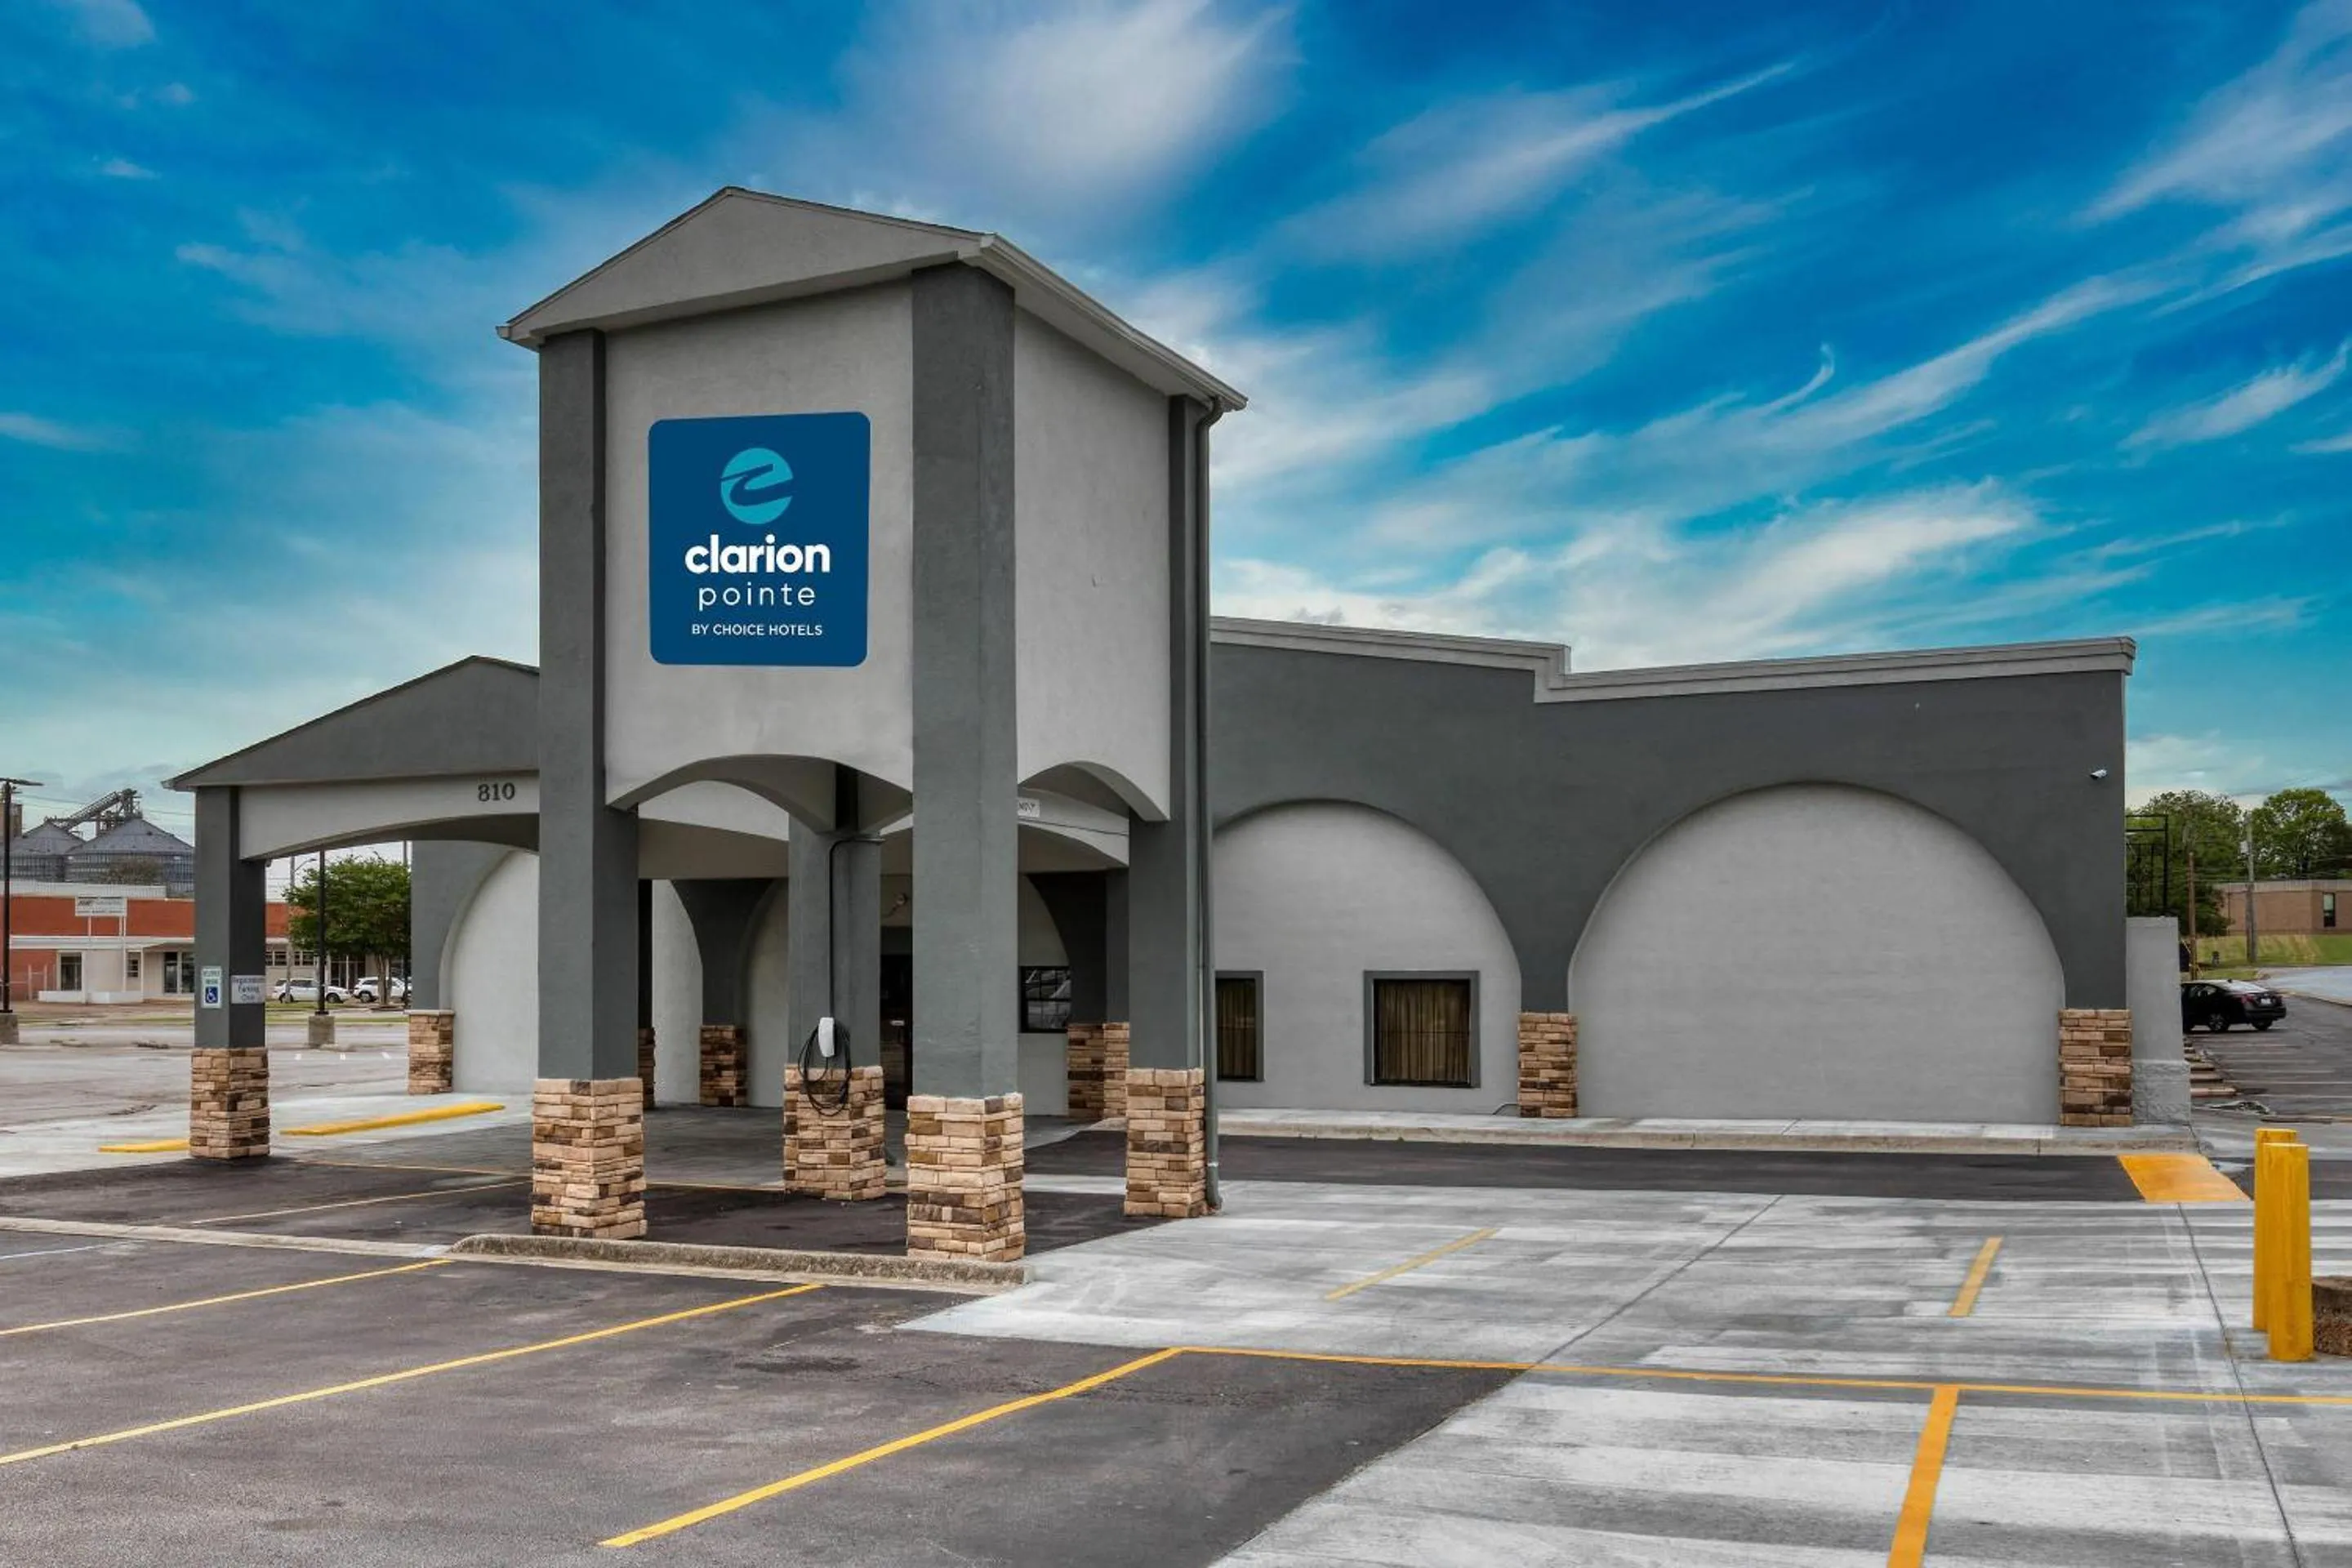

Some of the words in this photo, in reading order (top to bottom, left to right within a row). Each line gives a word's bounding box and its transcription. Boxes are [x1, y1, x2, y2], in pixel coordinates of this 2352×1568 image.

[684, 533, 831, 574] clarion
[698, 581, 816, 612] pointe
[692, 623, 710, 635] BY
[712, 623, 765, 635] CHOICE
[768, 624, 822, 636] HOTELS
[478, 782, 515, 802] 810
